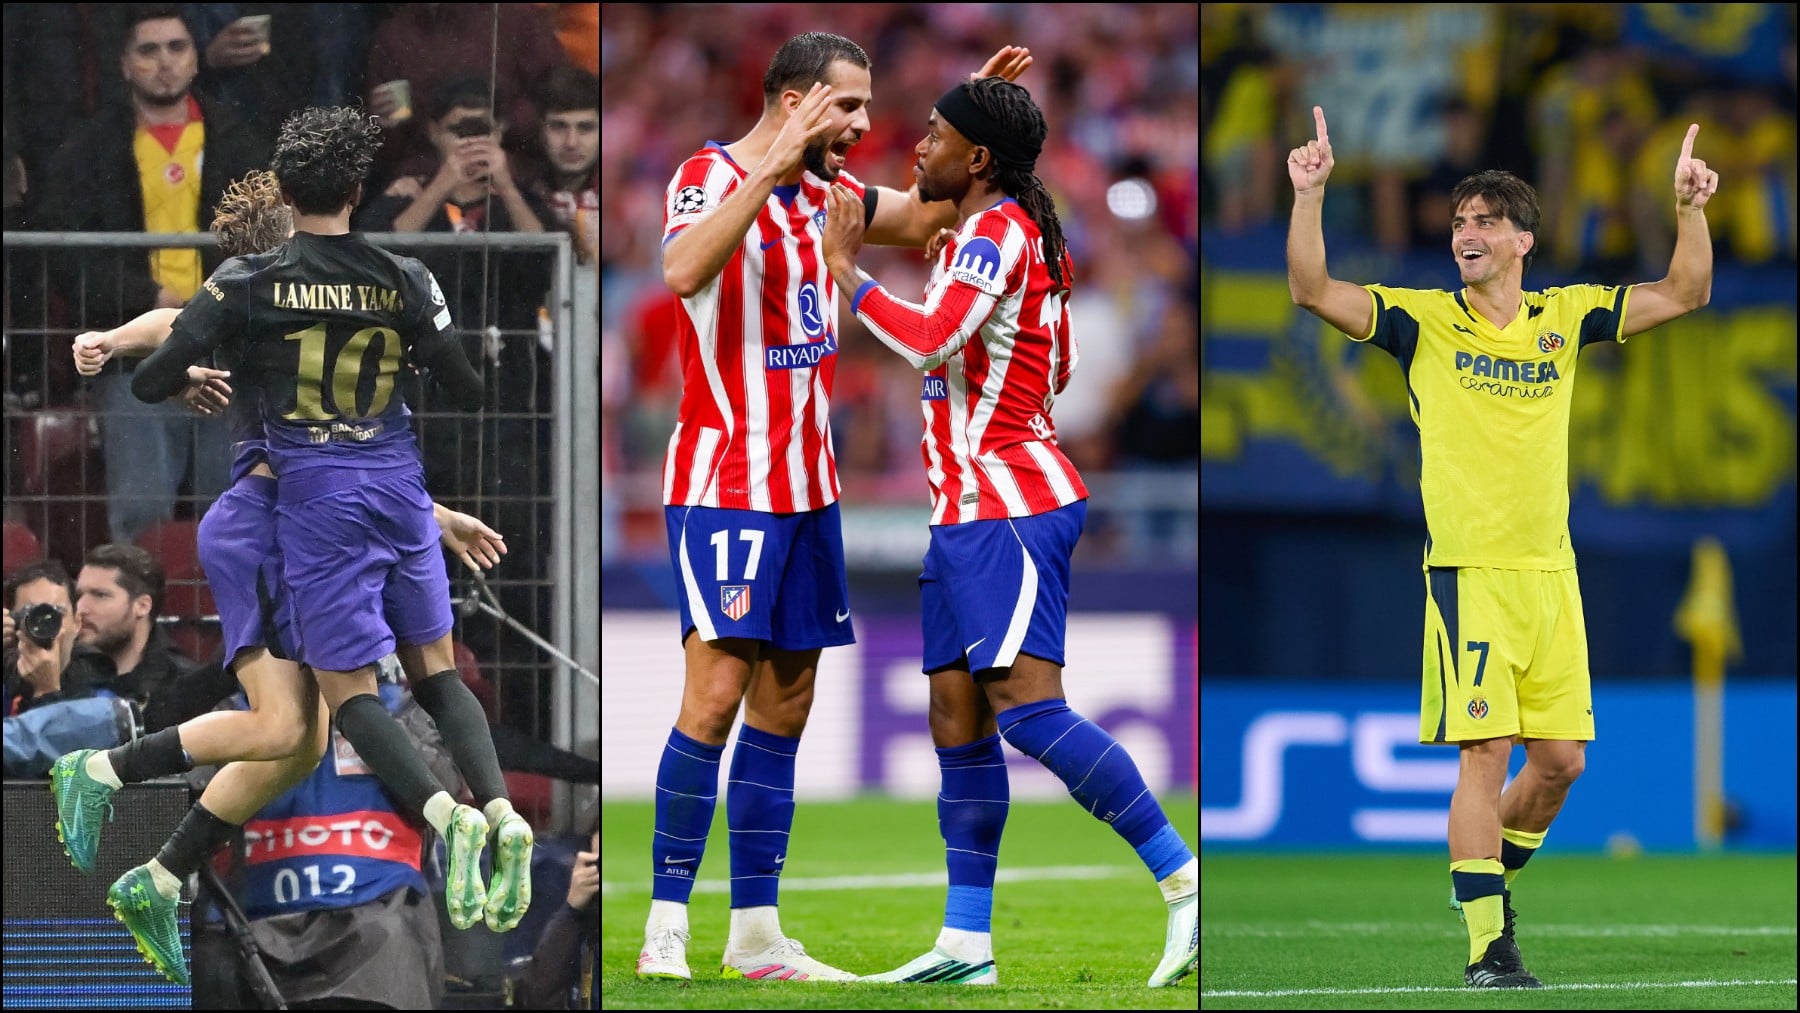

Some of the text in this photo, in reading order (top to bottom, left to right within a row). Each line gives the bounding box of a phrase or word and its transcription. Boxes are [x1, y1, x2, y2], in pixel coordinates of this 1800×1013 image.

[273, 282, 404, 312] LAMINE YAMA
[282, 320, 402, 420] 10
[1455, 351, 1560, 384] PAMESA
[710, 529, 765, 581] 17
[1466, 641, 1490, 687] 7
[244, 819, 394, 858] PHOTO
[273, 863, 356, 904] 012
